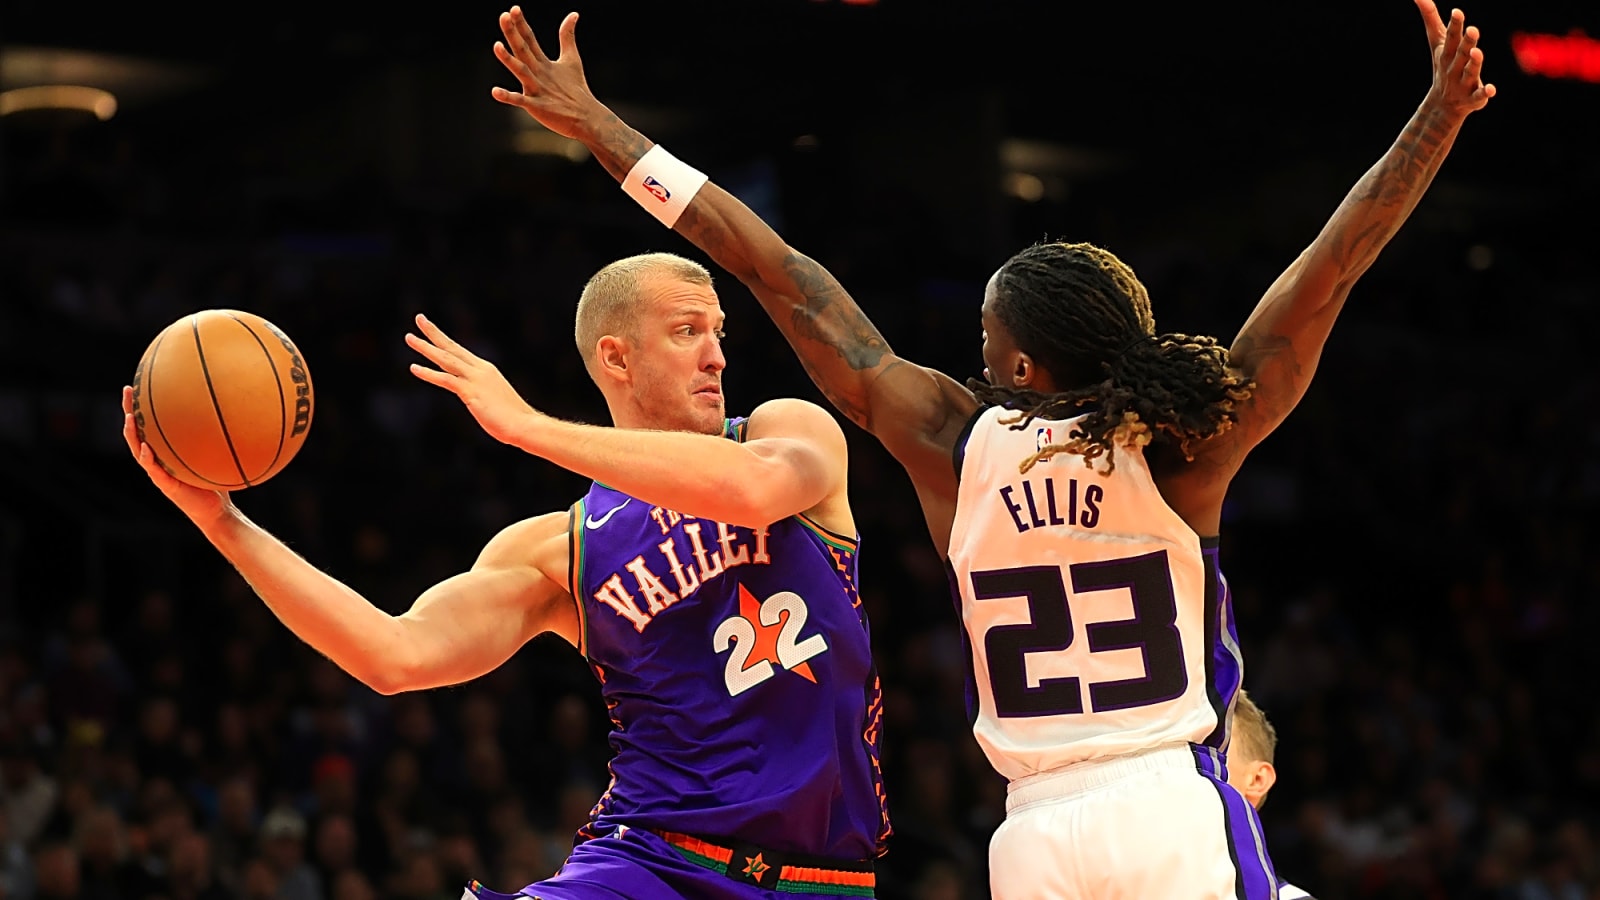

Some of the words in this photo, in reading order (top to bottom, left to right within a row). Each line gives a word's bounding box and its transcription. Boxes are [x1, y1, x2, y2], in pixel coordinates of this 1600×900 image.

[264, 320, 311, 439] Wilson
[999, 477, 1104, 533] ELLIS
[713, 591, 828, 697] 22
[970, 549, 1189, 718] 23
